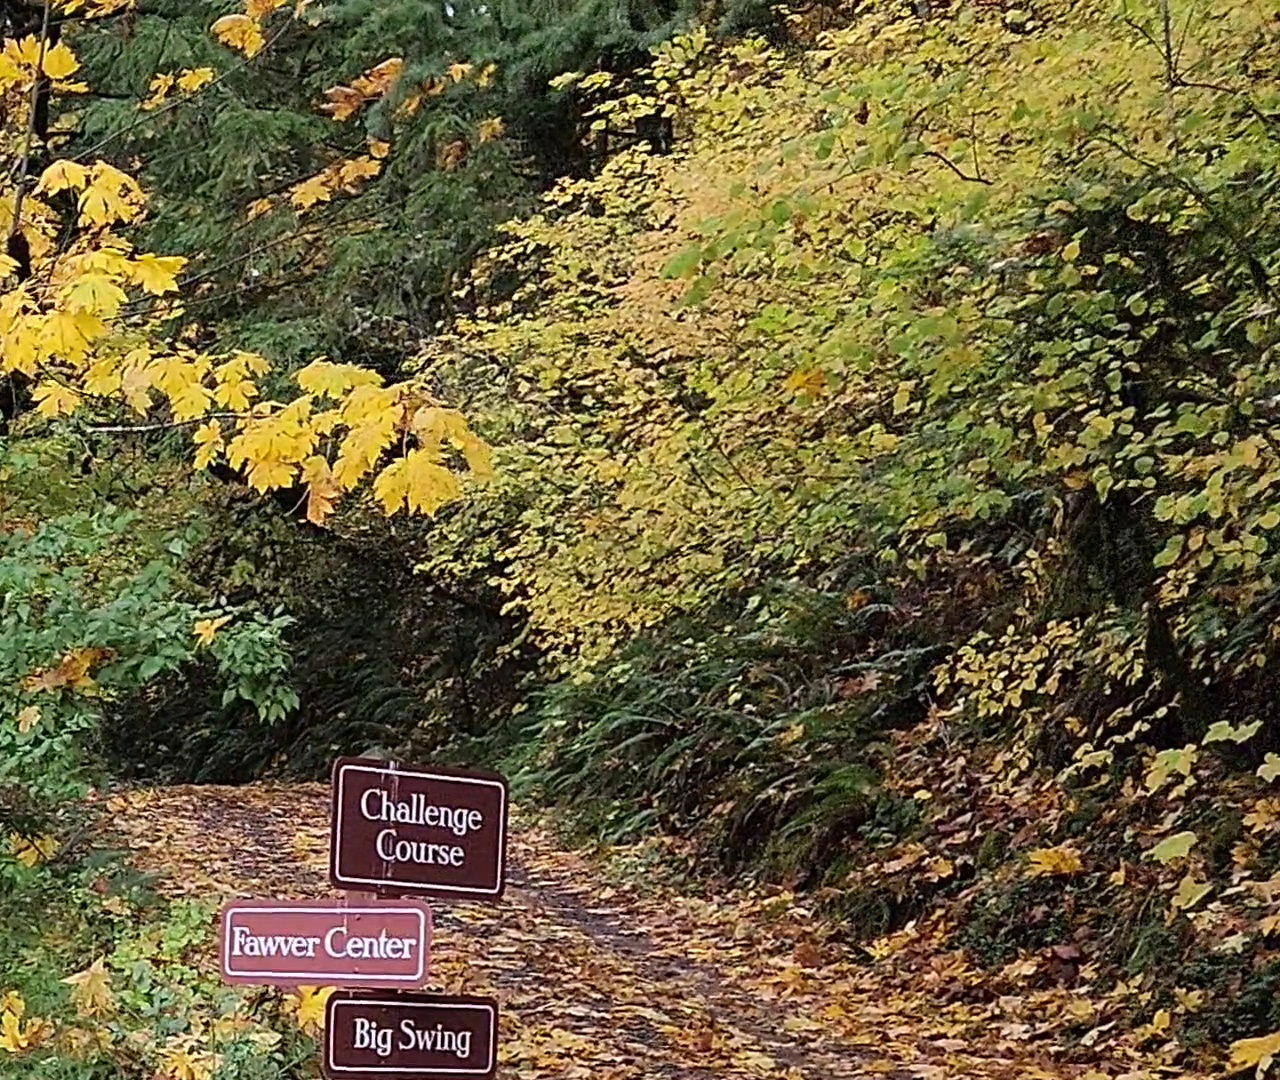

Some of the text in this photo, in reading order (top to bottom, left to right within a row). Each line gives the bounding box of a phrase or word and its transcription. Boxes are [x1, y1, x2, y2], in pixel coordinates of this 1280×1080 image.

[360, 788, 483, 835] Challenge
[376, 829, 465, 866] Course
[231, 926, 417, 960] Fawver Center
[353, 1017, 471, 1058] Big Swing
